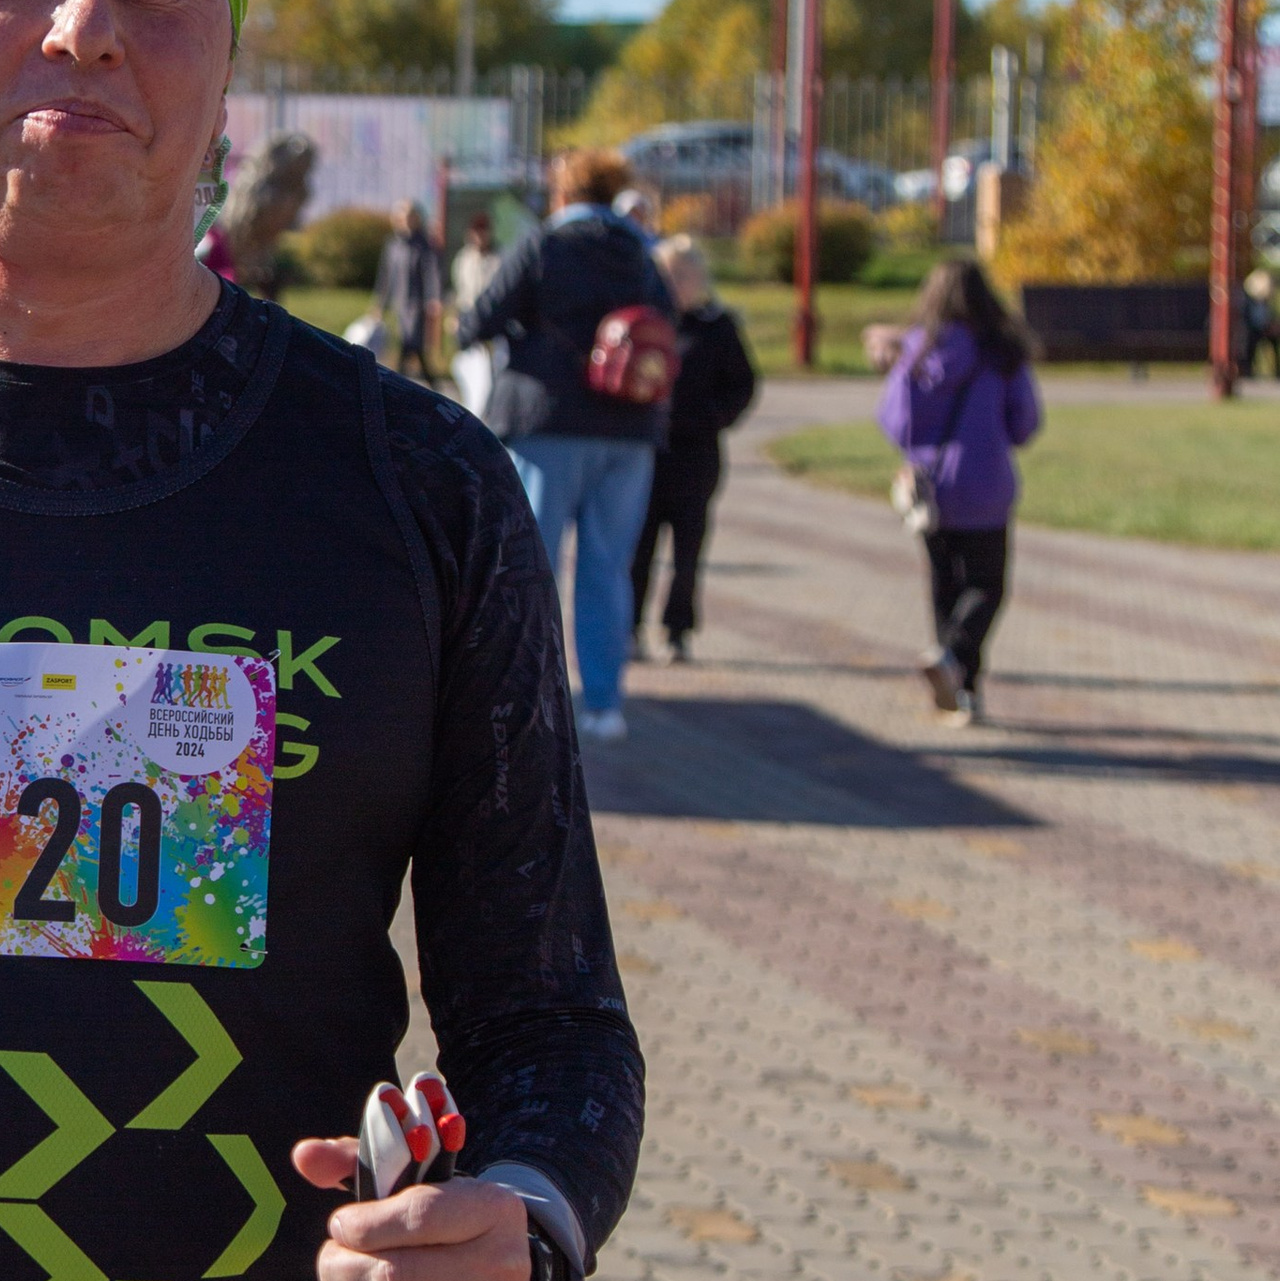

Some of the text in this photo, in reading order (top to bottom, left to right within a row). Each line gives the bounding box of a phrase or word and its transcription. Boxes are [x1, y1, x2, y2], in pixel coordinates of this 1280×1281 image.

[149, 708, 234, 726] ВСЕРОССИЙСКИЙ
[147, 722, 234, 742] ДЕНЬ ХОДЬБЫ
[176, 741, 205, 758] 2024
